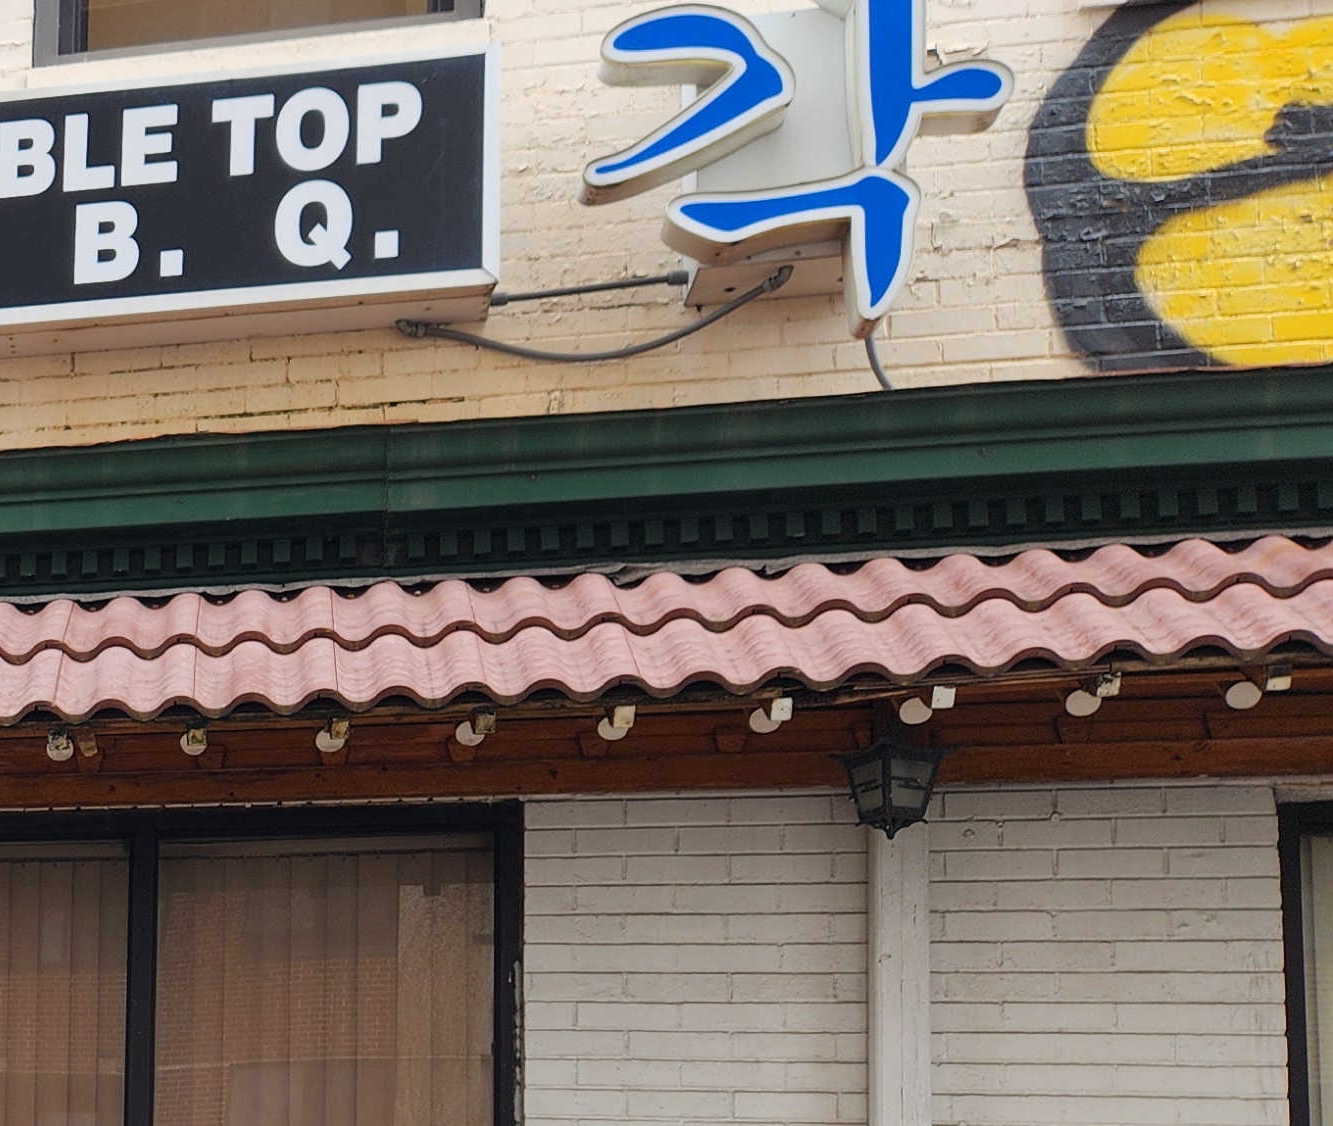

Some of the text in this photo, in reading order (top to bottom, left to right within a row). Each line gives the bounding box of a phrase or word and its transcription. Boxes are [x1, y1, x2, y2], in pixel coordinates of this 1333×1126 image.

[211, 80, 424, 177] TOP
[582, 0, 1014, 319] 각
[73, 200, 184, 285] B.
[274, 179, 400, 271] Q.
